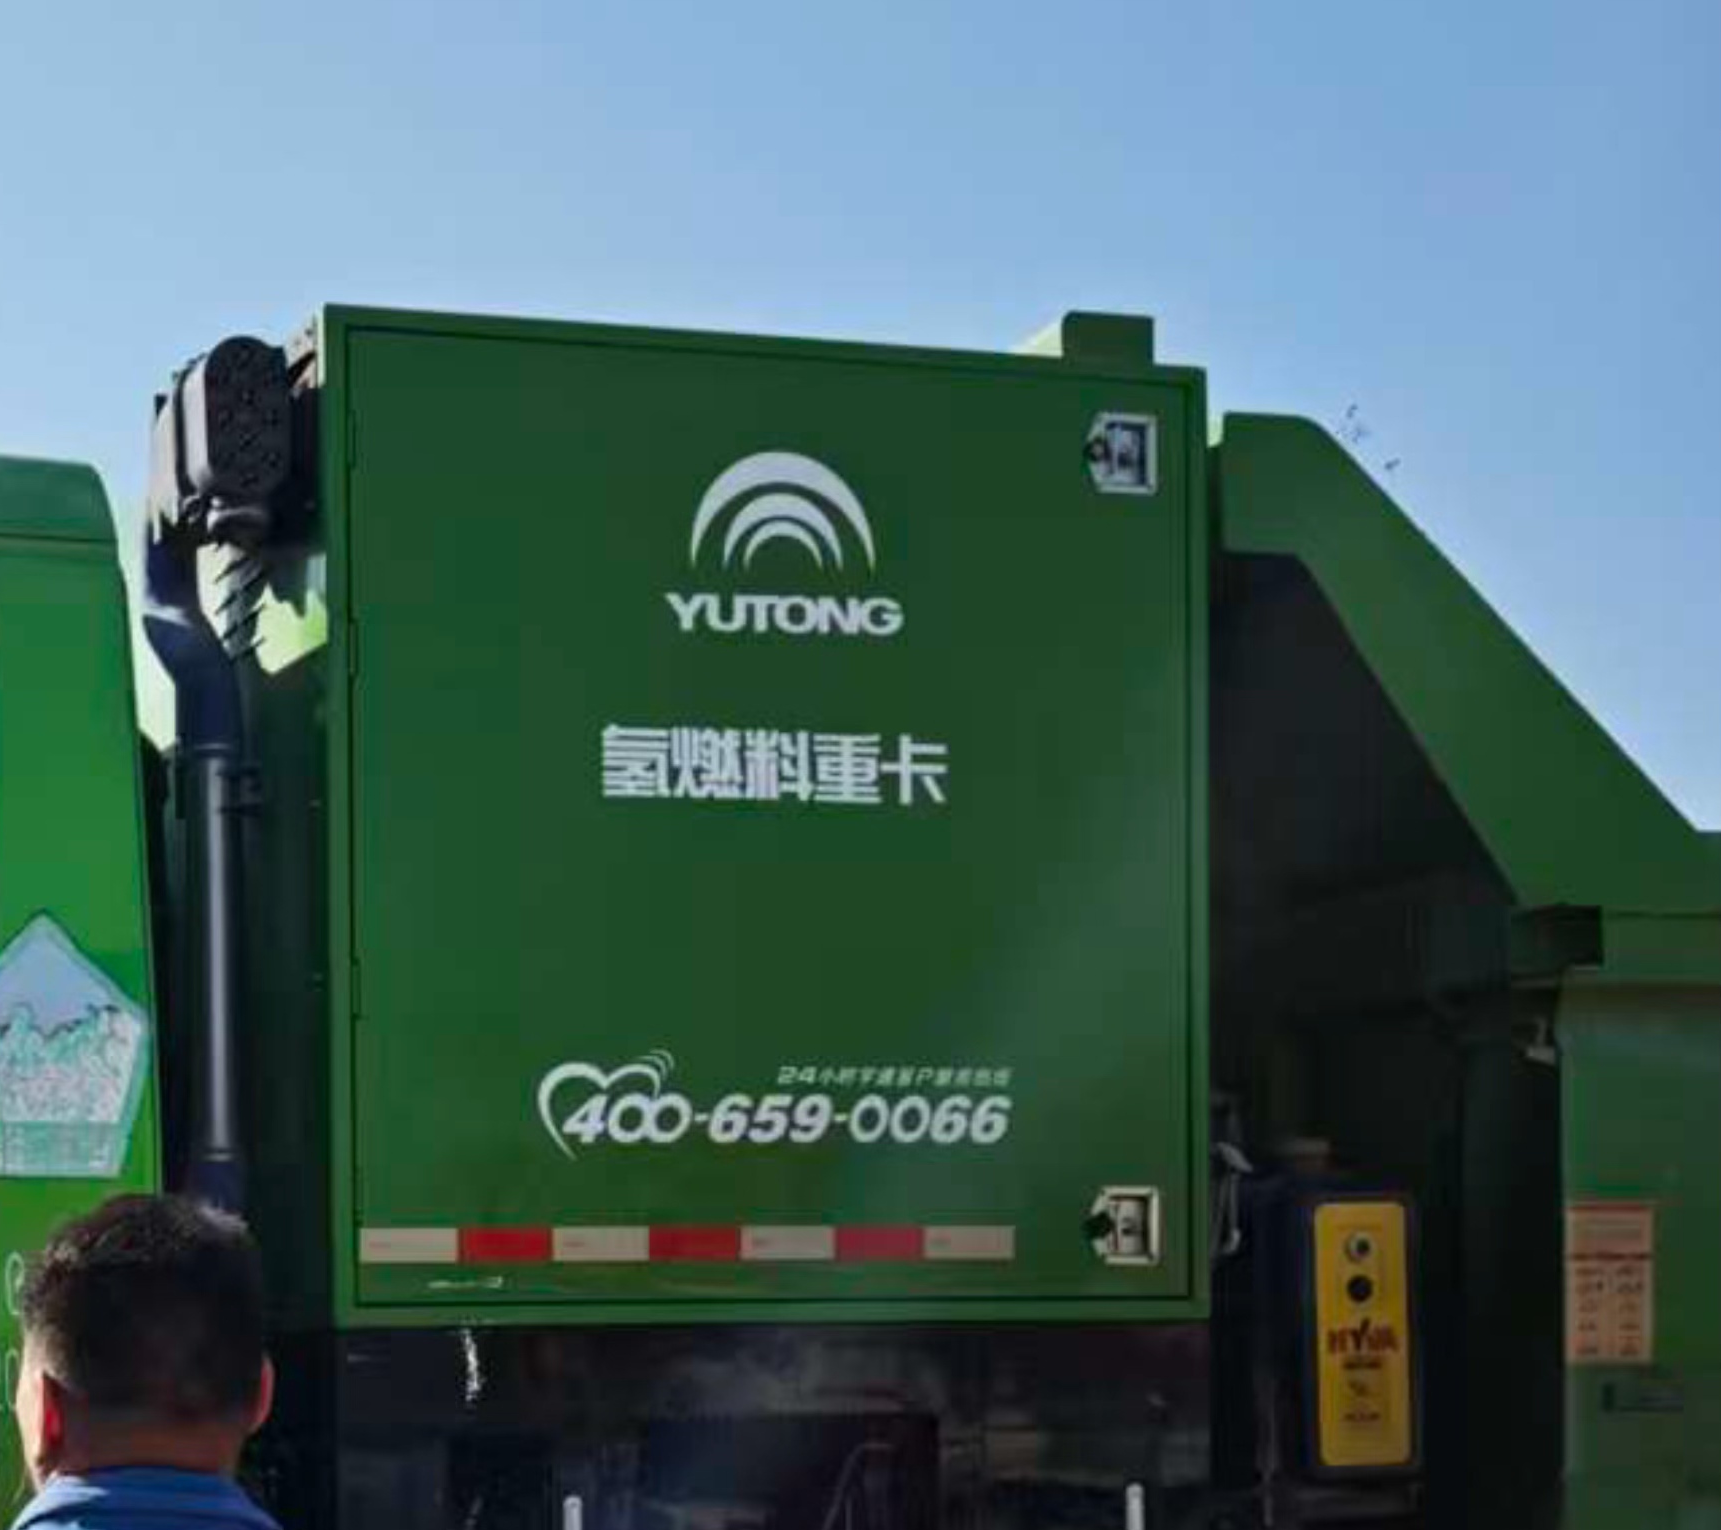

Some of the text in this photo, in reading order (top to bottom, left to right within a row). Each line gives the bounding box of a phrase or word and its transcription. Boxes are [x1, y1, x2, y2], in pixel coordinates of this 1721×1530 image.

[665, 592, 905, 636] YUTONG
[602, 723, 948, 806] 氢燃料重卡
[562, 1092, 1013, 1144] 400-659-0066
